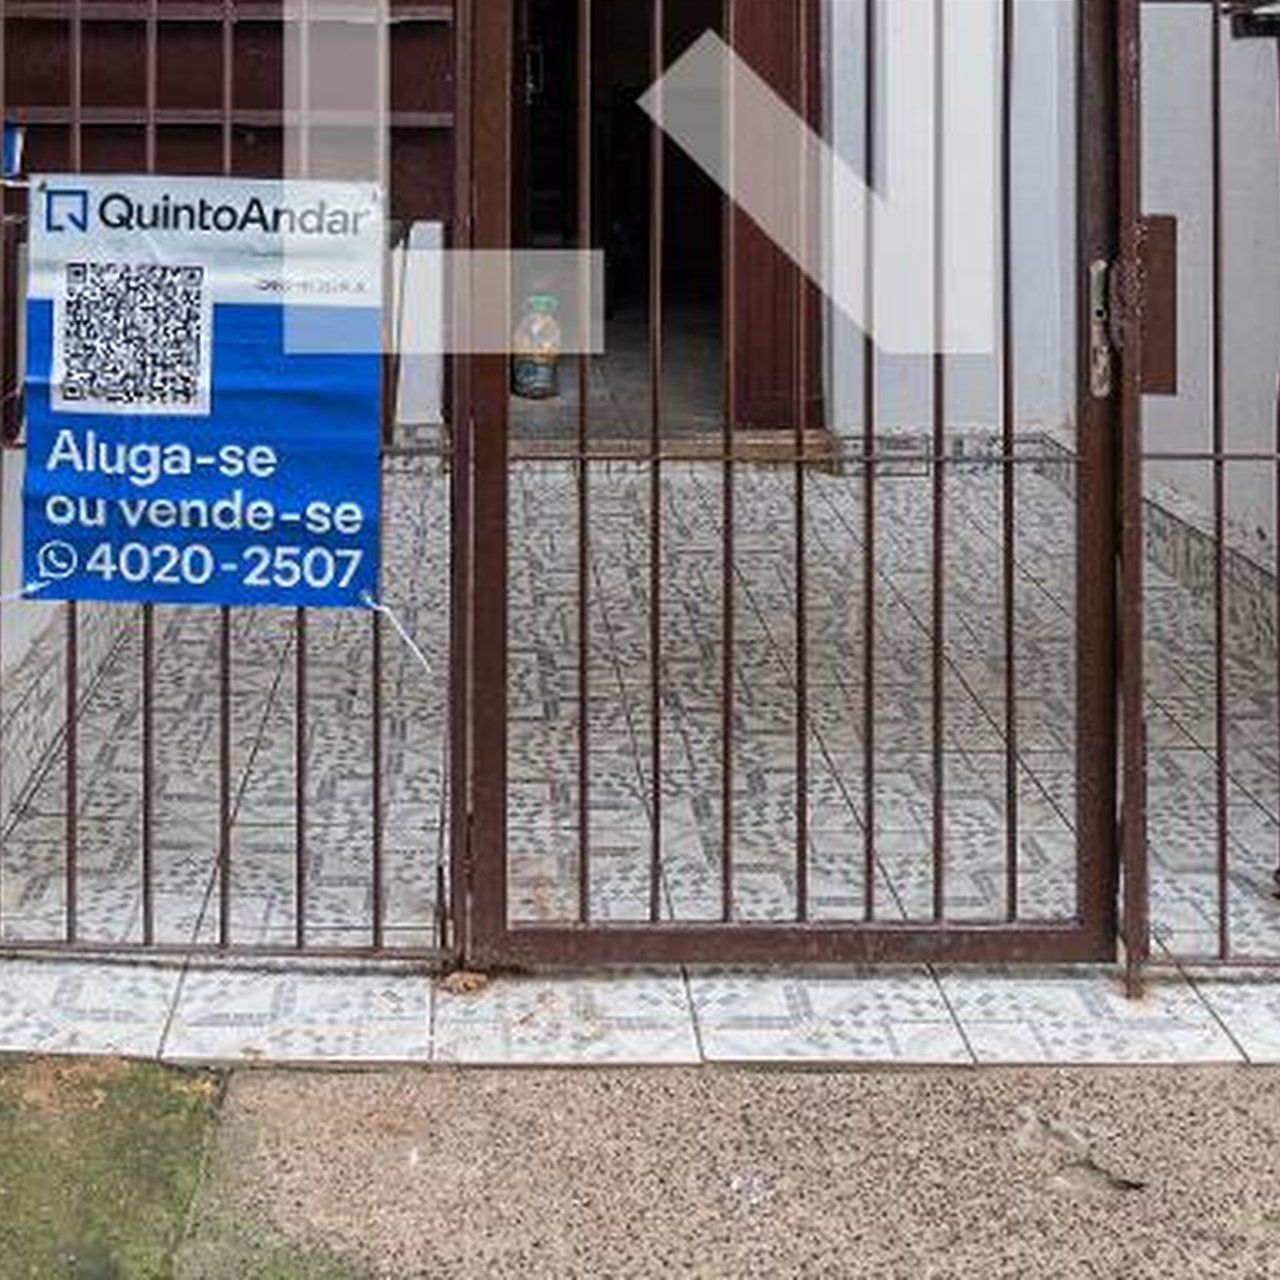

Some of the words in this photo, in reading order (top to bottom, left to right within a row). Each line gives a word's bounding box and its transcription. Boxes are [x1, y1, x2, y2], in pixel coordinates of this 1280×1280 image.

[98, 192, 371, 236] QuintoAndar
[46, 429, 278, 487] Aluga-se
[45, 494, 107, 526] ou
[119, 489, 365, 534] vende-se
[85, 542, 365, 588] 4020-2507
